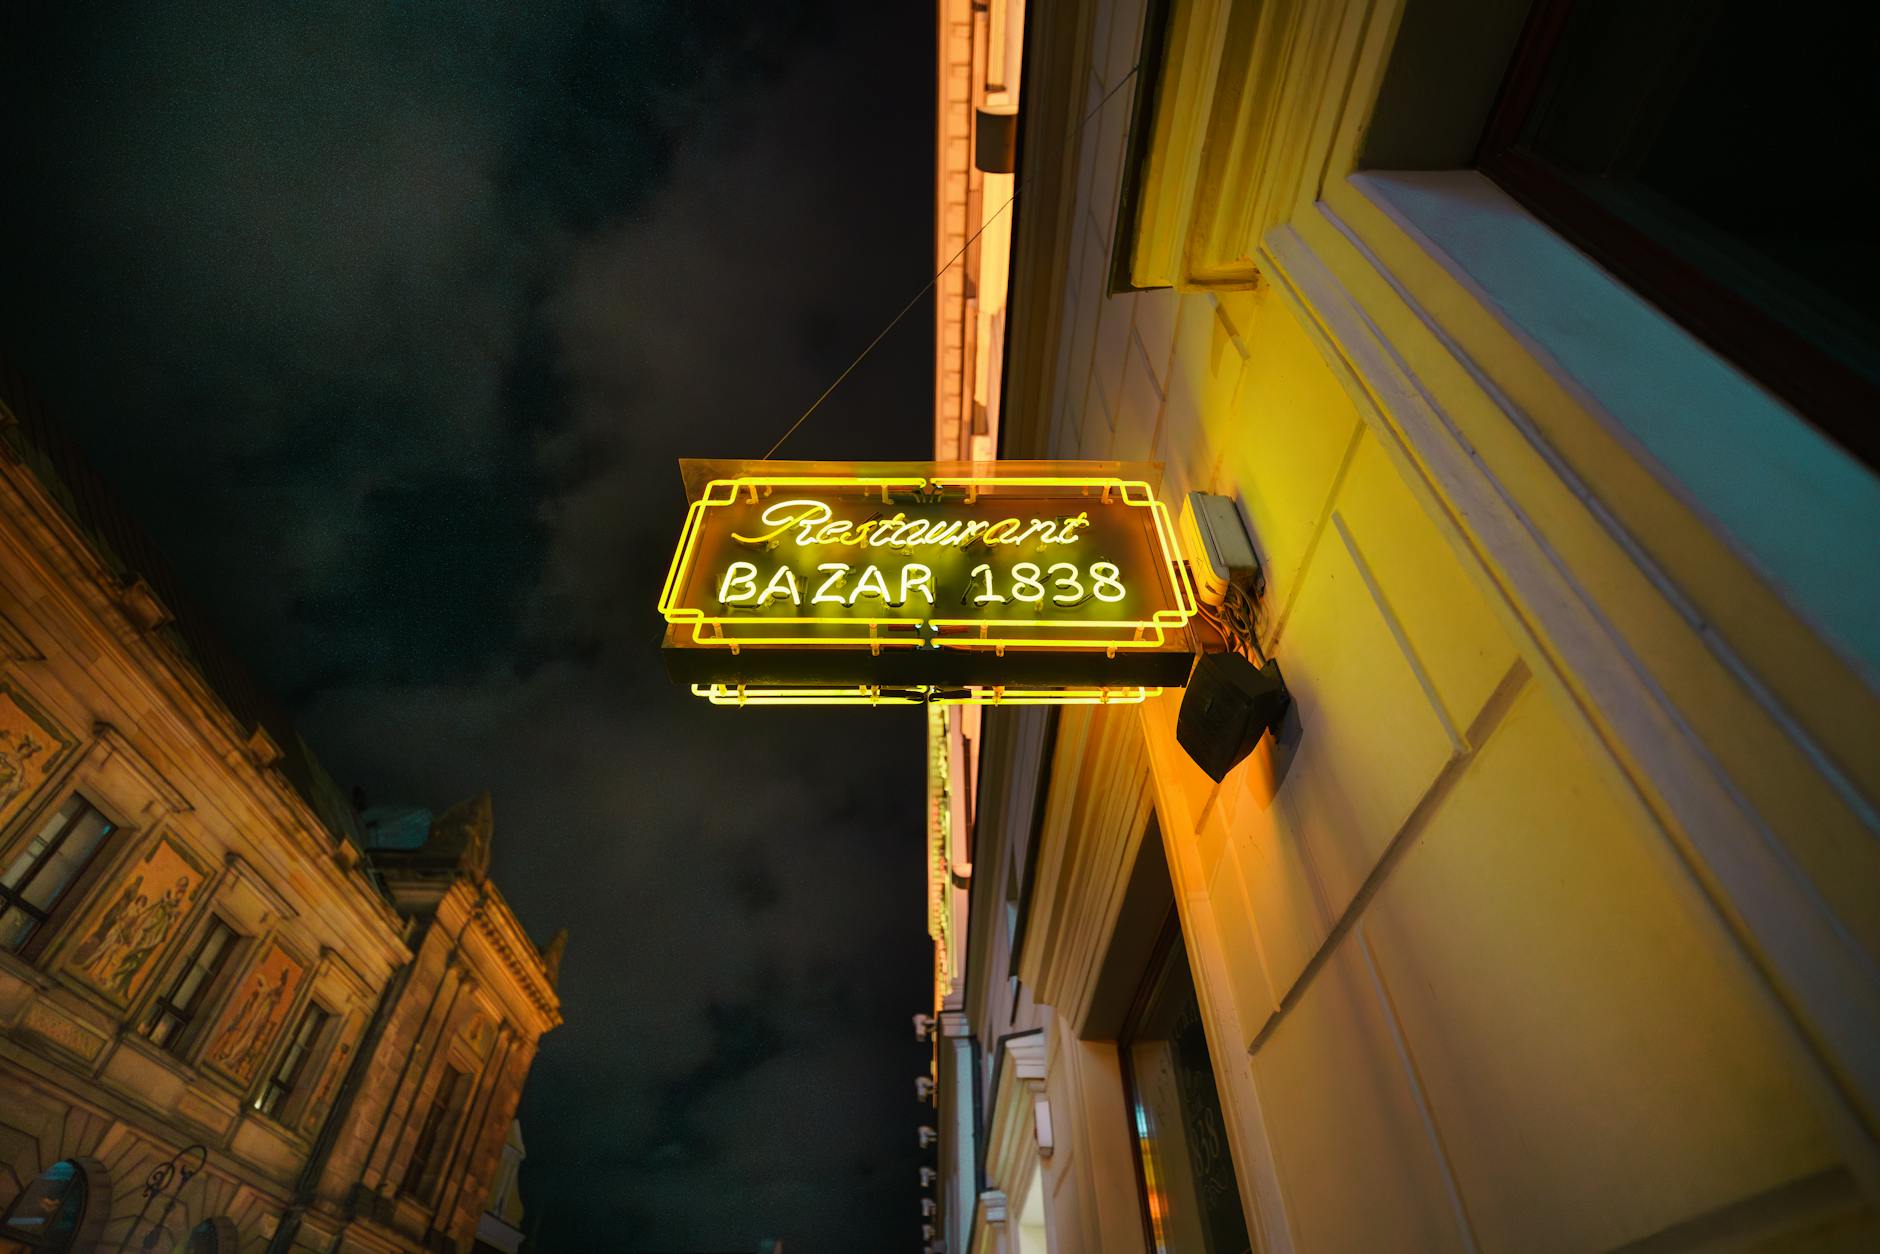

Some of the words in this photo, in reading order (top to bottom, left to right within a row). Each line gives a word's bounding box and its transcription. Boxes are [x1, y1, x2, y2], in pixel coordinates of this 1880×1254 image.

[731, 500, 1089, 546] Restaurant
[718, 561, 935, 605] BAZAR
[971, 562, 1126, 604] 1838
